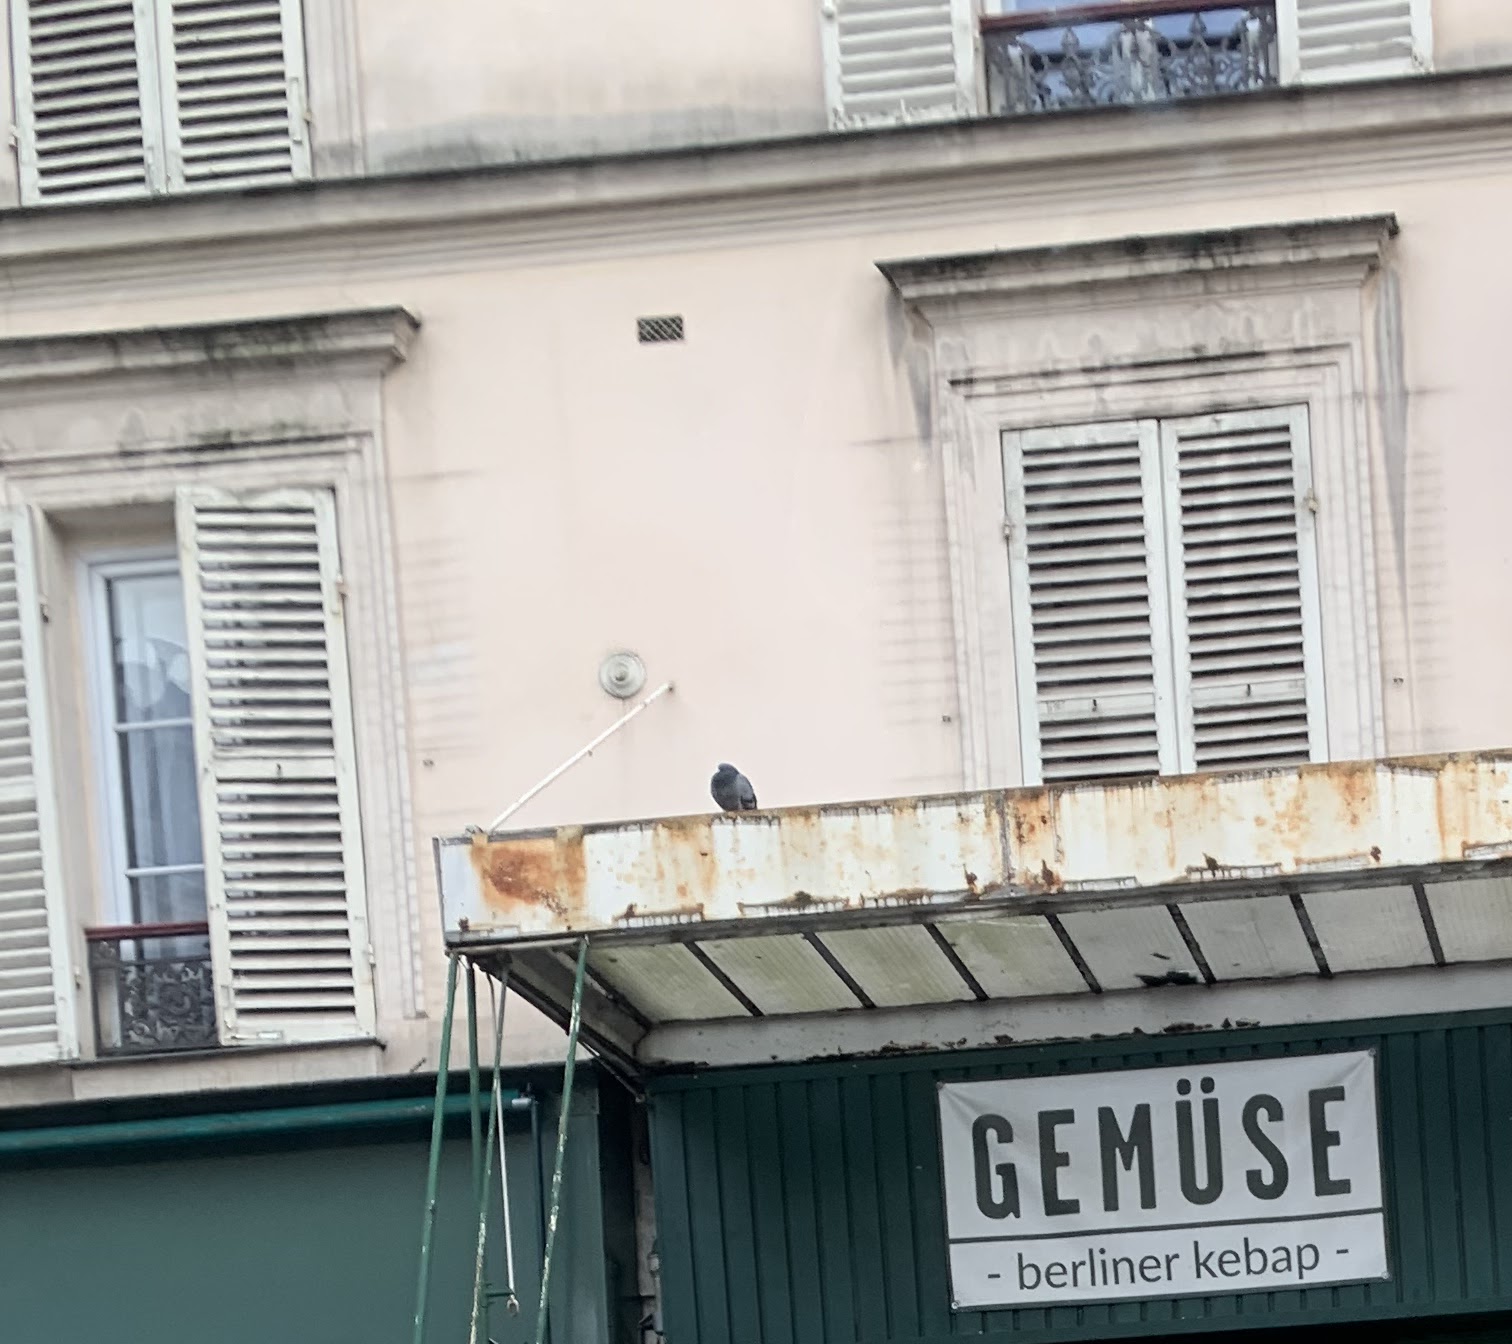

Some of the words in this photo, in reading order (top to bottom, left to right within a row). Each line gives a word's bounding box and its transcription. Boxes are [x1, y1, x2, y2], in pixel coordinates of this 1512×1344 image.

[971, 1076, 1351, 1220] GEMÜSE
[1016, 1248, 1180, 1291] berliner
[1193, 1237, 1320, 1279] kebap
